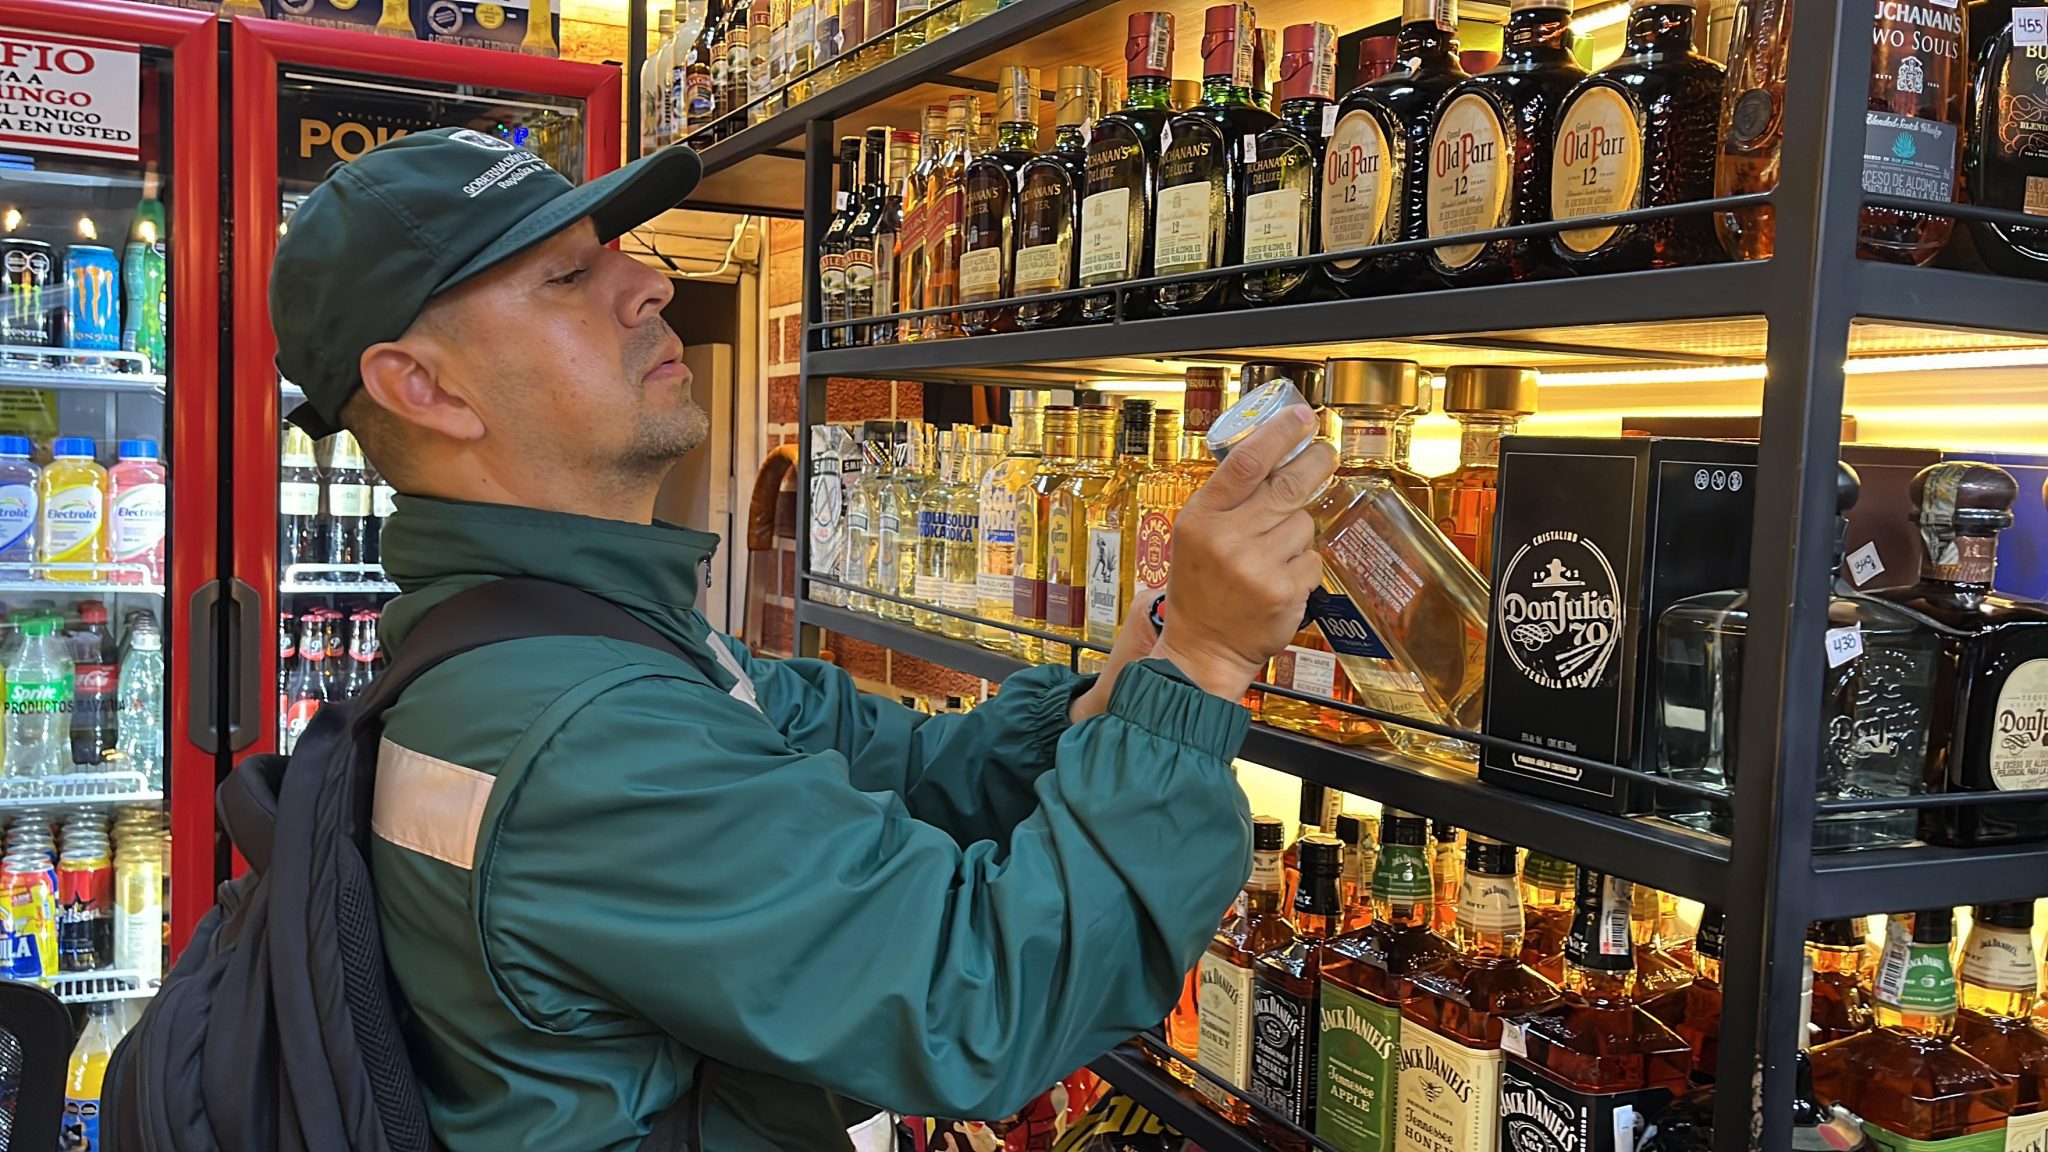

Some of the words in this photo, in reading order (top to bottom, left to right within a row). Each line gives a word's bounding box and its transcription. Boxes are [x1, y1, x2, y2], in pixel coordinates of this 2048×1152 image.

[2018, 17, 2043, 34] 455
[1872, 27, 1905, 47] WO
[27, 73, 43, 85] A
[24, 105, 101, 125] UNICO
[20, 120, 52, 134] EN
[58, 123, 131, 141] USTED
[1087, 145, 1131, 168] CHANAN'S
[1164, 142, 1212, 163] CHANAN'S
[1436, 140, 1460, 179] Old
[1460, 132, 1495, 174] Parr
[1563, 130, 1589, 168] Old
[1590, 126, 1626, 165] Parr
[1328, 150, 1350, 186] Old
[1350, 145, 1379, 182] Parr
[1454, 175, 1468, 197] 12
[1581, 166, 1598, 187] 12
[1892, 173, 1905, 189] DE
[1905, 176, 1939, 196] ALCOHOL
[1940, 182, 1949, 197] ES
[1344, 184, 1357, 203] 12
[1171, 220, 1180, 234] 12
[1263, 223, 1271, 235] 12
[1093, 232, 1101, 247] 12
[73, 332, 120, 344] ONSTER
[47, 508, 98, 520] Electrolit
[1141, 519, 1171, 545] OLMECA
[1532, 531, 1579, 547] CRISTALINO
[1139, 557, 1171, 584] TEQUILA
[1318, 615, 1369, 641] 1800
[1568, 622, 1609, 646] 70
[1833, 634, 1858, 652] 438
[11, 685, 58, 700] Sprite
[3, 700, 75, 715] PRODUCTOS
[1200, 1025, 1231, 1051] HONEY
[1320, 1006, 1345, 1033] JACK
[1346, 1005, 1396, 1061] DANIEL'S
[1327, 1064, 1375, 1100] Tennessee
[1400, 1047, 1425, 1073] JACK
[1425, 1045, 1475, 1105] DANIEL'S
[1329, 1084, 1371, 1113] APPLE
[1405, 1106, 1454, 1146] Tennessee
[1501, 1089, 1526, 1118] JACK
[1526, 1088, 1579, 1152] DANIEL'S
